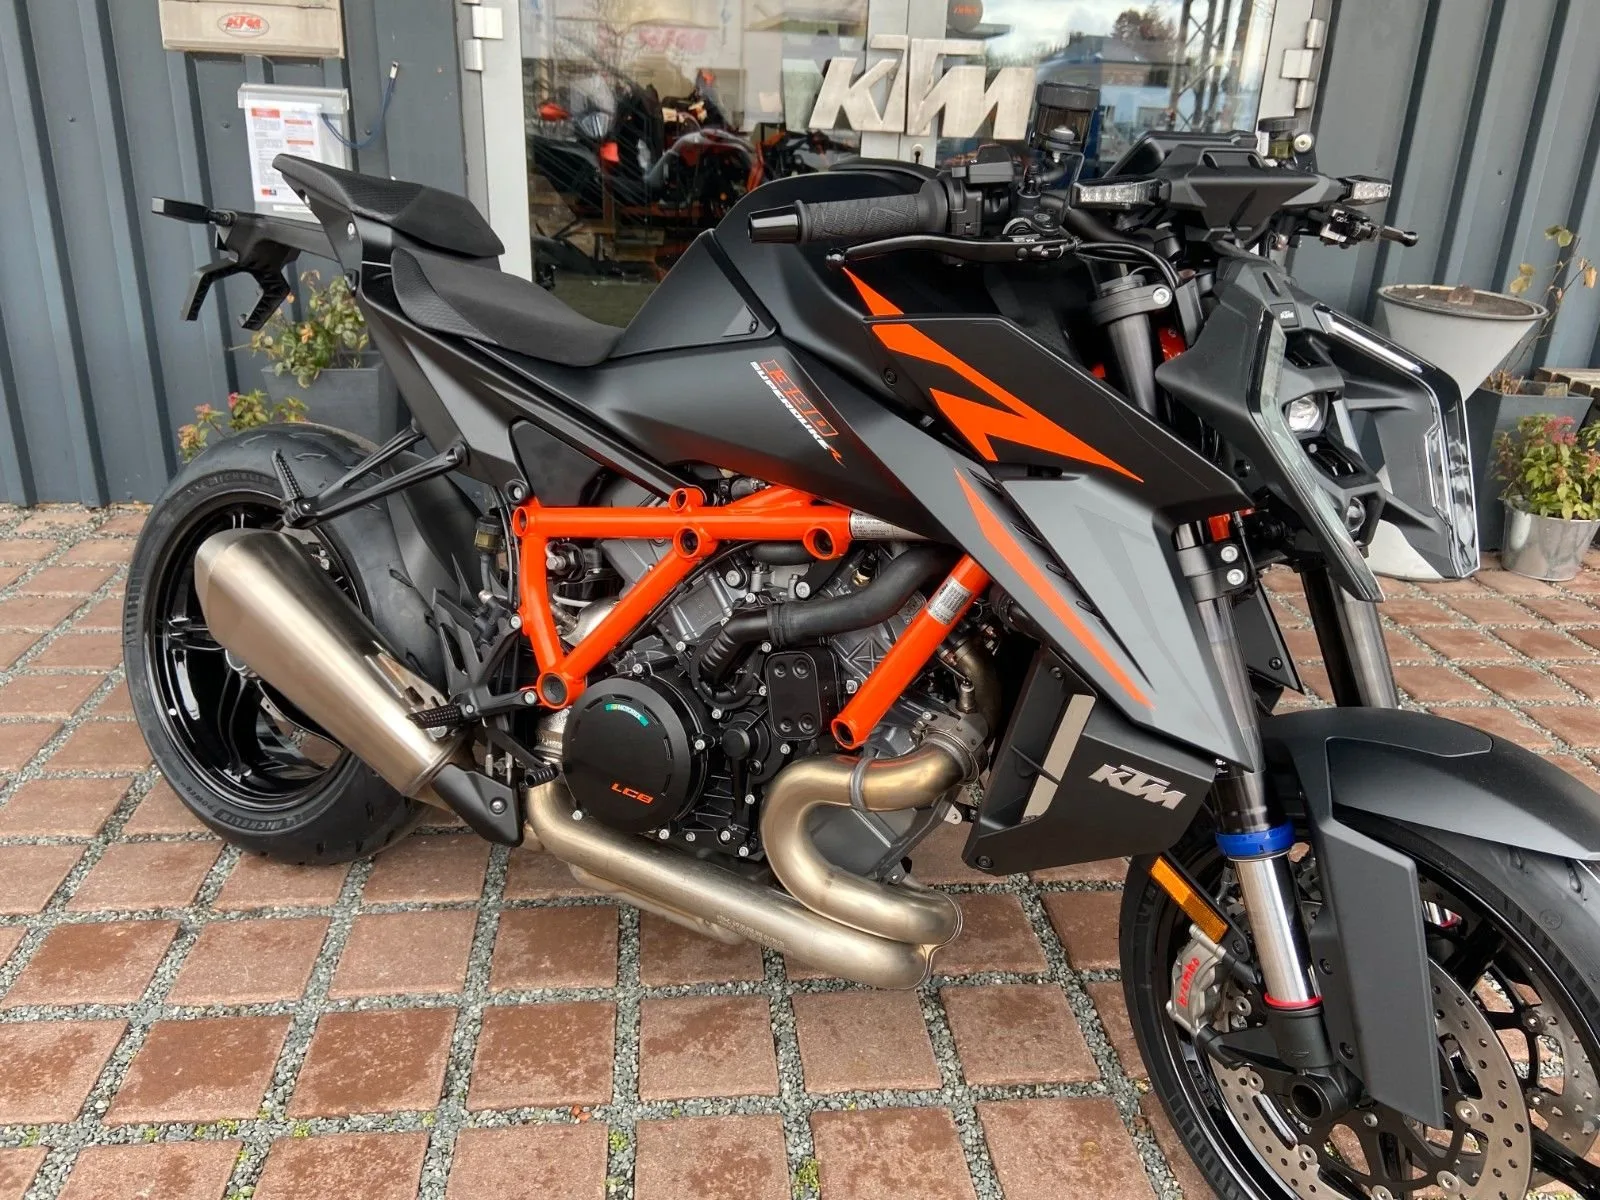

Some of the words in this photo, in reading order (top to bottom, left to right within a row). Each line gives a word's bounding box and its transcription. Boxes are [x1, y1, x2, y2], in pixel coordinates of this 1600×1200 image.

[809, 34, 1036, 140] KTM
[611, 783, 654, 804] LC8
[1088, 764, 1187, 810] KTM
[1177, 957, 1200, 1008] brembo
